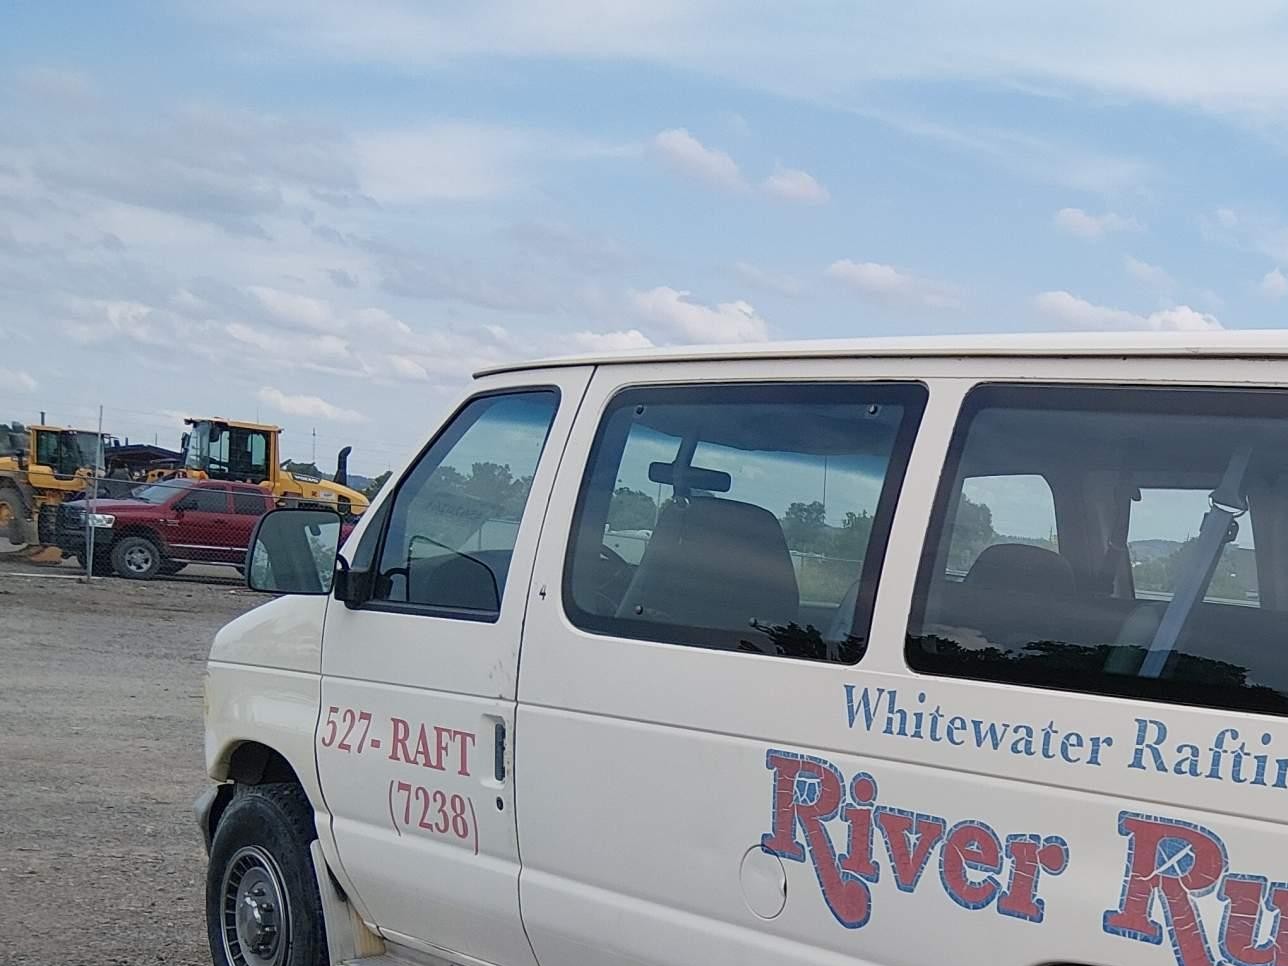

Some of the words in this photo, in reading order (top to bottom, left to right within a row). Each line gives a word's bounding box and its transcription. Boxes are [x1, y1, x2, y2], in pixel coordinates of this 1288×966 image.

[320, 706, 381, 752] 527-
[387, 717, 477, 778] RAFT
[843, 683, 1113, 766] Whitewater
[388, 779, 480, 856] (7238)
[760, 748, 1071, 930] River
